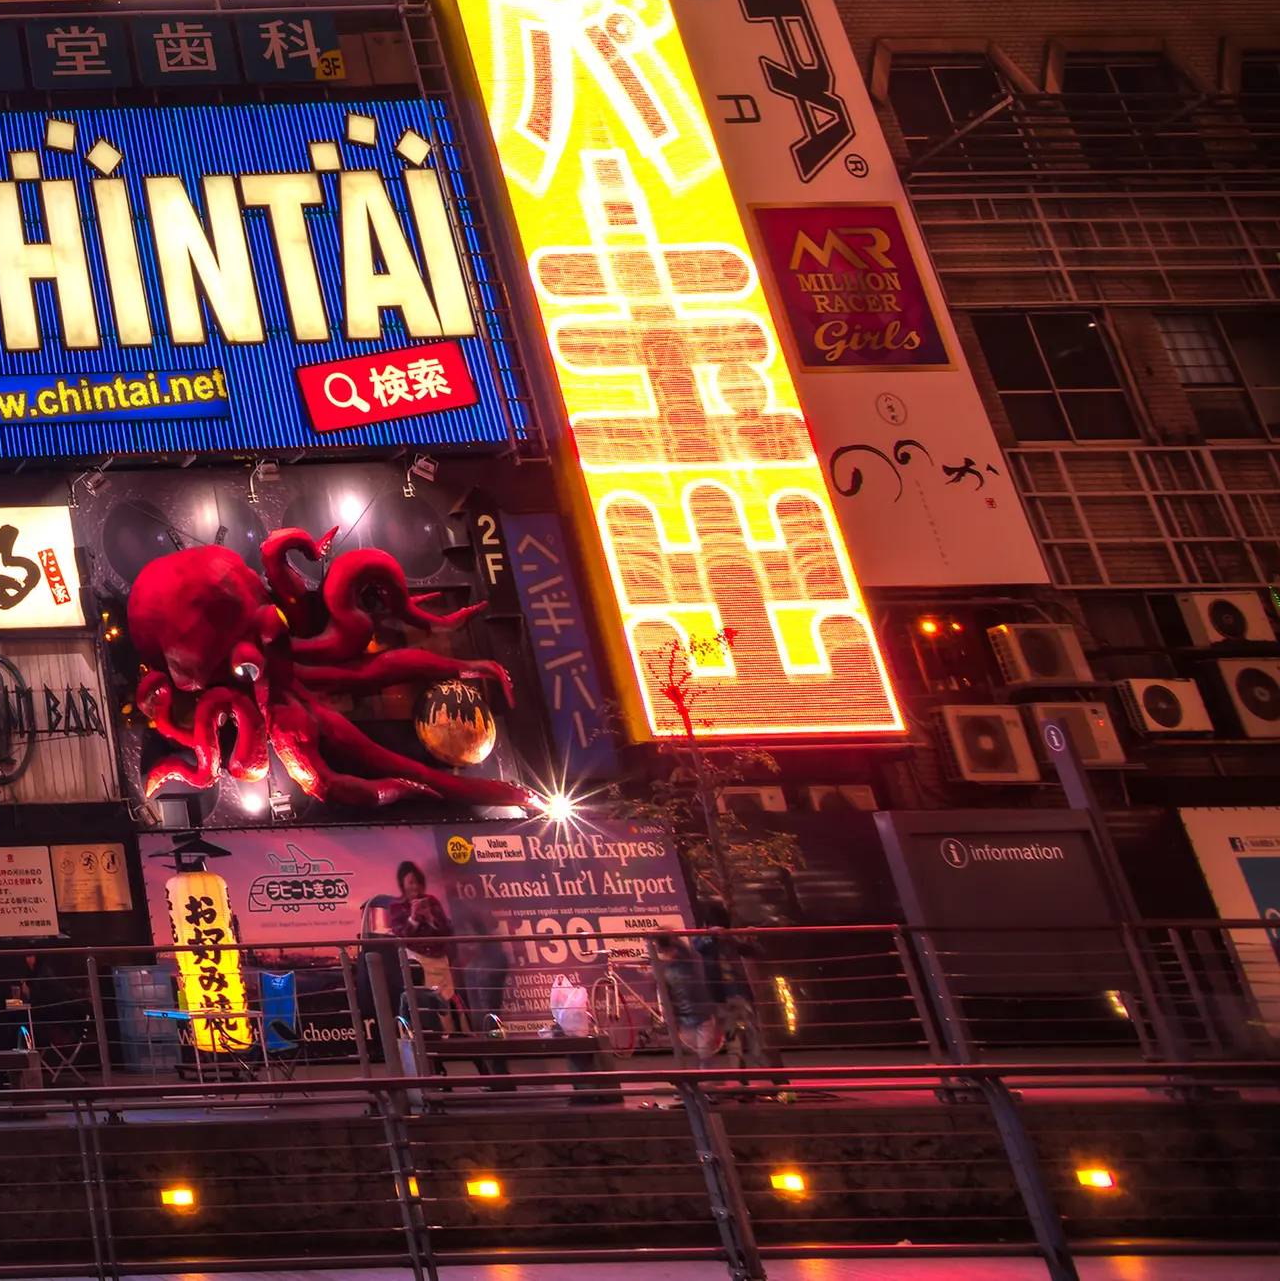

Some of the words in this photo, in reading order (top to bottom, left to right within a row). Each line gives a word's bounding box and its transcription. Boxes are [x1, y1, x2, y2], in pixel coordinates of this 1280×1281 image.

[321, 58, 341, 76] 3F
[796, 272, 901, 293] MILLION
[812, 294, 901, 313] RACER
[814, 320, 920, 362] Girls
[368, 358, 452, 409] 検索
[487, 839, 508, 849] Value
[526, 835, 588, 867] Rapid
[592, 835, 666, 866] Express
[970, 843, 1064, 863] information
[452, 852, 469, 860] OFF
[477, 849, 503, 860] Railway
[504, 848, 523, 858] ticket
[479, 873, 550, 899] Kansai
[602, 871, 676, 903] Airport
[624, 919, 660, 928] NAMBA
